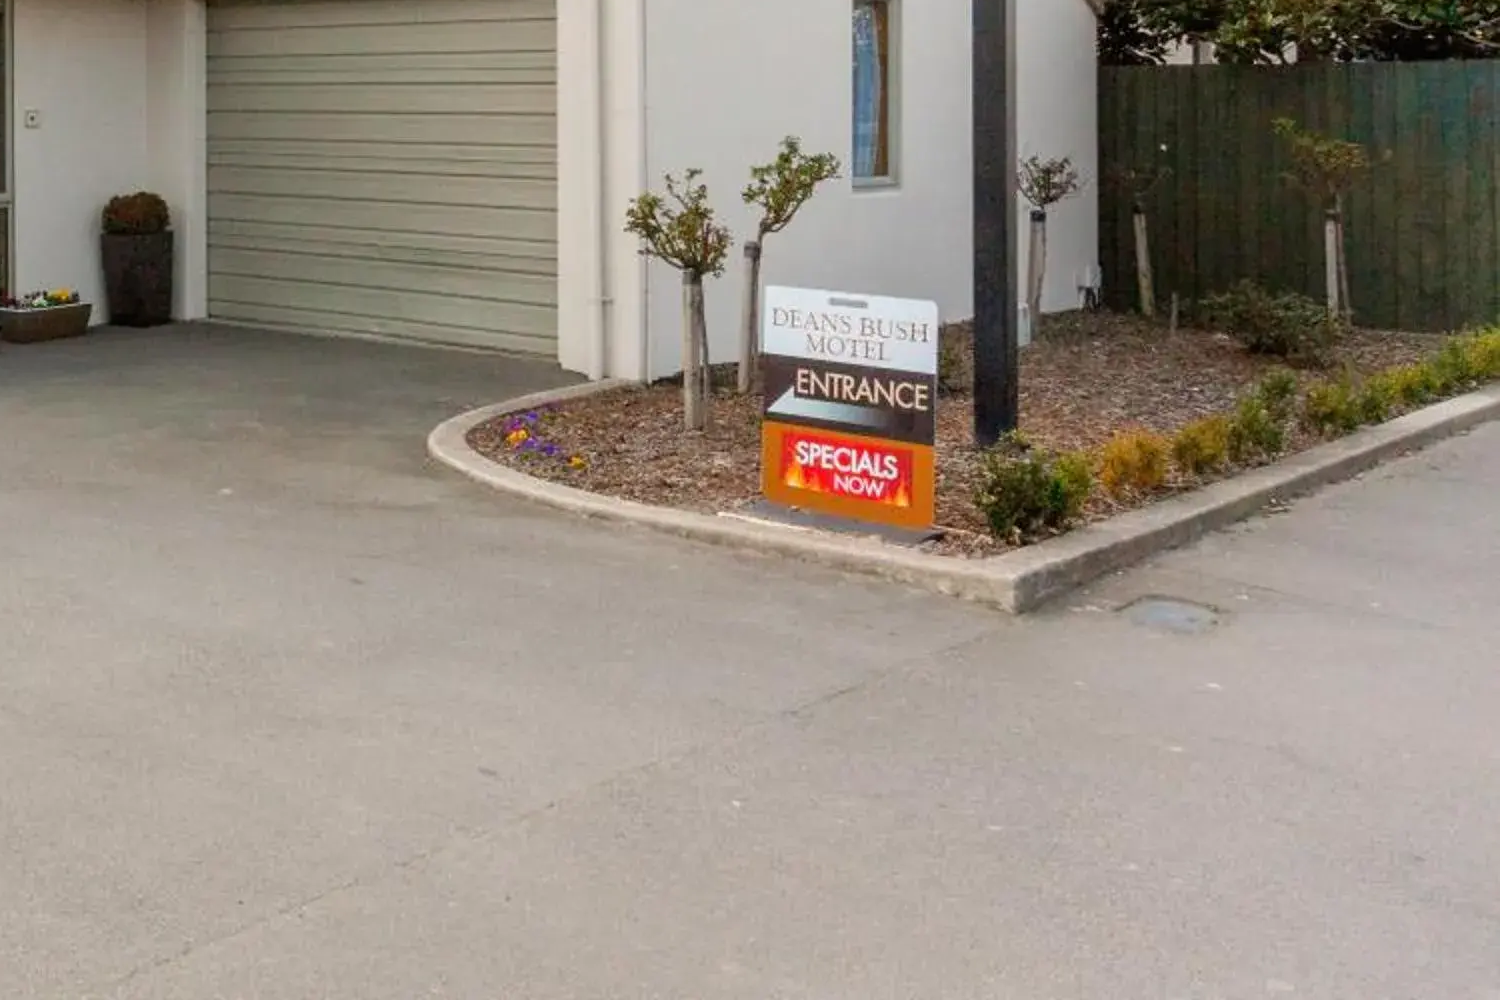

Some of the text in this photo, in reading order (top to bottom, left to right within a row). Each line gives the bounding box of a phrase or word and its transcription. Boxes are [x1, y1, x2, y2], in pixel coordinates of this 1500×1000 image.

[772, 307, 929, 343] DEANS BUSH
[806, 334, 889, 361] MOTEL
[796, 368, 928, 412] ENTRANCE
[794, 441, 898, 480] SPECIALS
[833, 475, 885, 497] NOW
